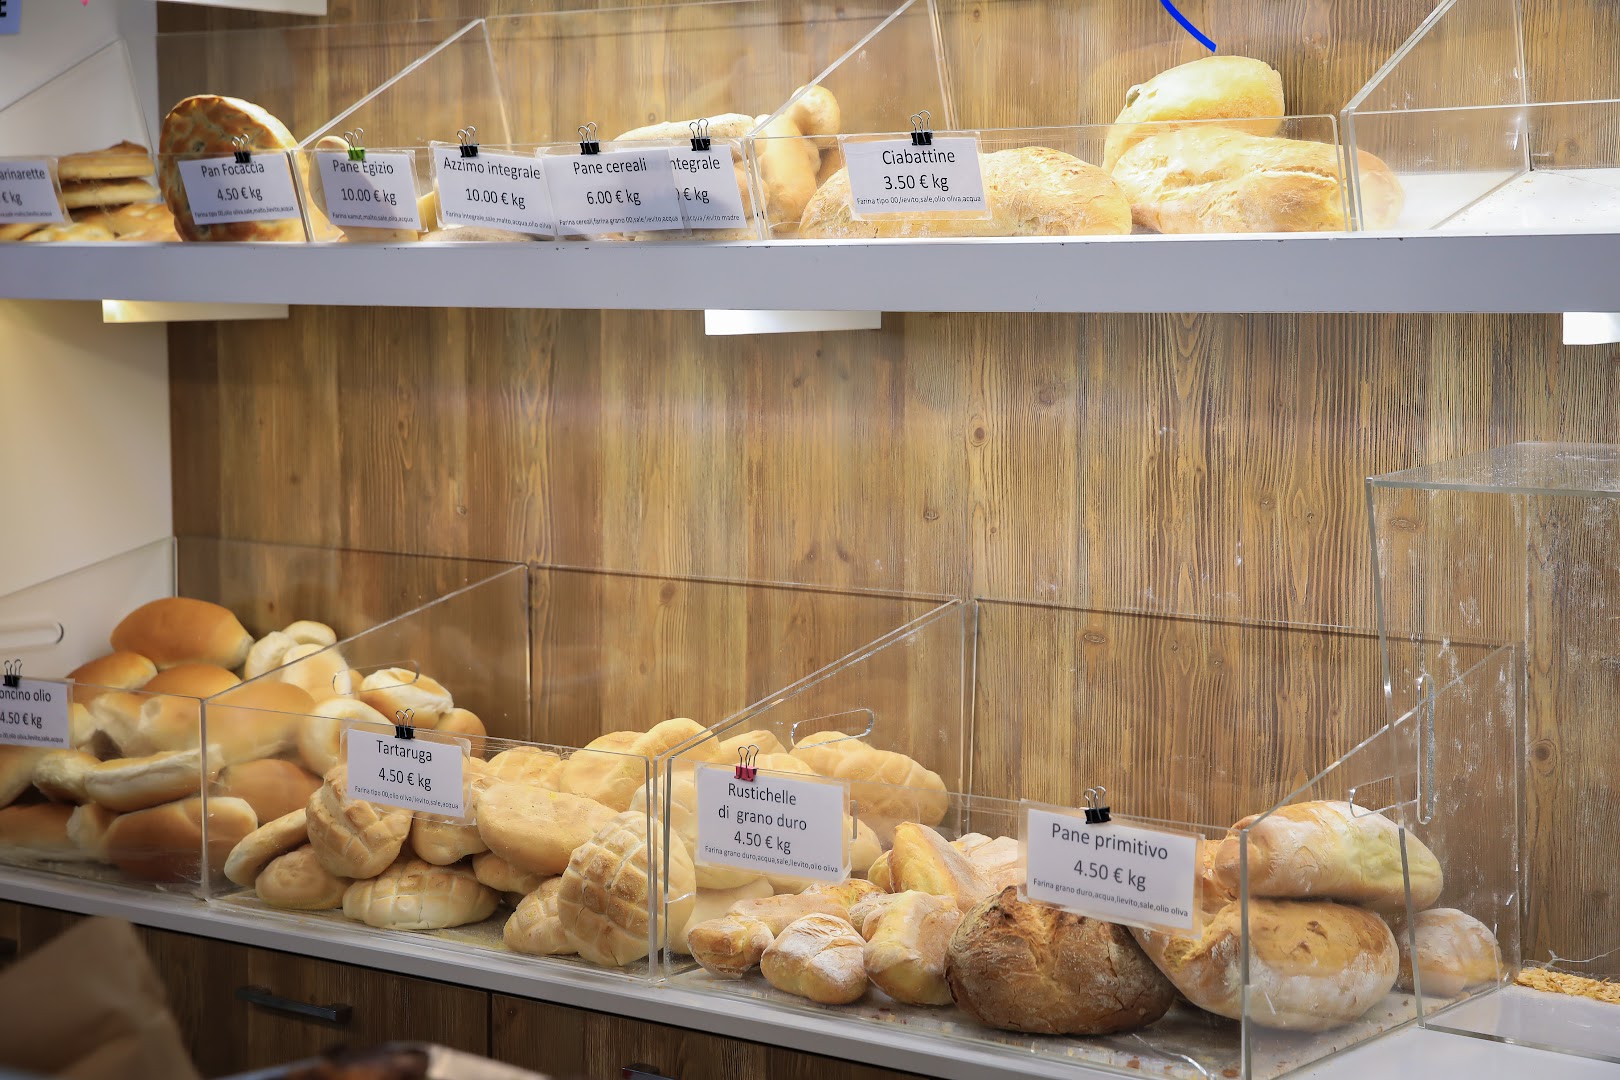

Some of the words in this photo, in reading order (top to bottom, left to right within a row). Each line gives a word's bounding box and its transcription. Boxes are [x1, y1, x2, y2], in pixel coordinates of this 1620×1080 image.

[573, 161, 603, 175] Pane
[606, 157, 647, 173] cereali
[882, 149, 956, 165] Ciabattine
[201, 164, 221, 178] Pan
[222, 160, 265, 176] Focaccia
[332, 159, 360, 173] Pane
[362, 159, 394, 177] Egizio
[443, 157, 485, 174] Azzimo
[487, 161, 541, 180] integrale
[883, 175, 916, 190] 3.50
[919, 175, 929, 189] €
[931, 173, 949, 192] kg
[10, 190, 23, 206] kg
[217, 187, 239, 202] 4.50
[241, 186, 249, 200] €
[249, 185, 263, 202] kg
[341, 188, 371, 202] 10.00
[373, 189, 381, 203] €
[382, 189, 397, 206] kg
[465, 188, 498, 204] 10.00
[500, 192, 509, 205] €
[511, 193, 526, 210] kg
[586, 190, 613, 205] 6.00
[615, 190, 624, 204] €
[625, 189, 642, 206] kg
[683, 187, 692, 201] €
[693, 187, 710, 204] kg
[856, 197, 876, 205] Farina
[876, 197, 890, 206] tipo
[33, 688, 52, 702] olio
[22, 712, 29, 725] €
[31, 712, 43, 729] kg
[376, 740, 432, 764] Tartaruga
[378, 767, 404, 784] 4.50
[407, 772, 415, 786] €
[418, 773, 432, 792] kg
[728, 782, 797, 806] Rustichelle
[718, 805, 729, 819] di
[736, 810, 773, 825] grano
[777, 813, 807, 831] duro
[734, 831, 762, 848] 4.50
[765, 835, 773, 849] €
[776, 836, 791, 855] kg
[1052, 822, 1090, 845] Pane
[1095, 834, 1168, 860] primitivo
[704, 845, 723, 855] Farina
[723, 849, 741, 858] grano
[1073, 860, 1109, 880] 4.50
[1113, 867, 1124, 883] €
[1128, 869, 1146, 892] kg
[1033, 878, 1054, 890] Farina
[1055, 884, 1076, 894] grano
[1076, 888, 1170, 913] duro,acqua,lievito,sale,olio
[1170, 907, 1189, 918] oliva
